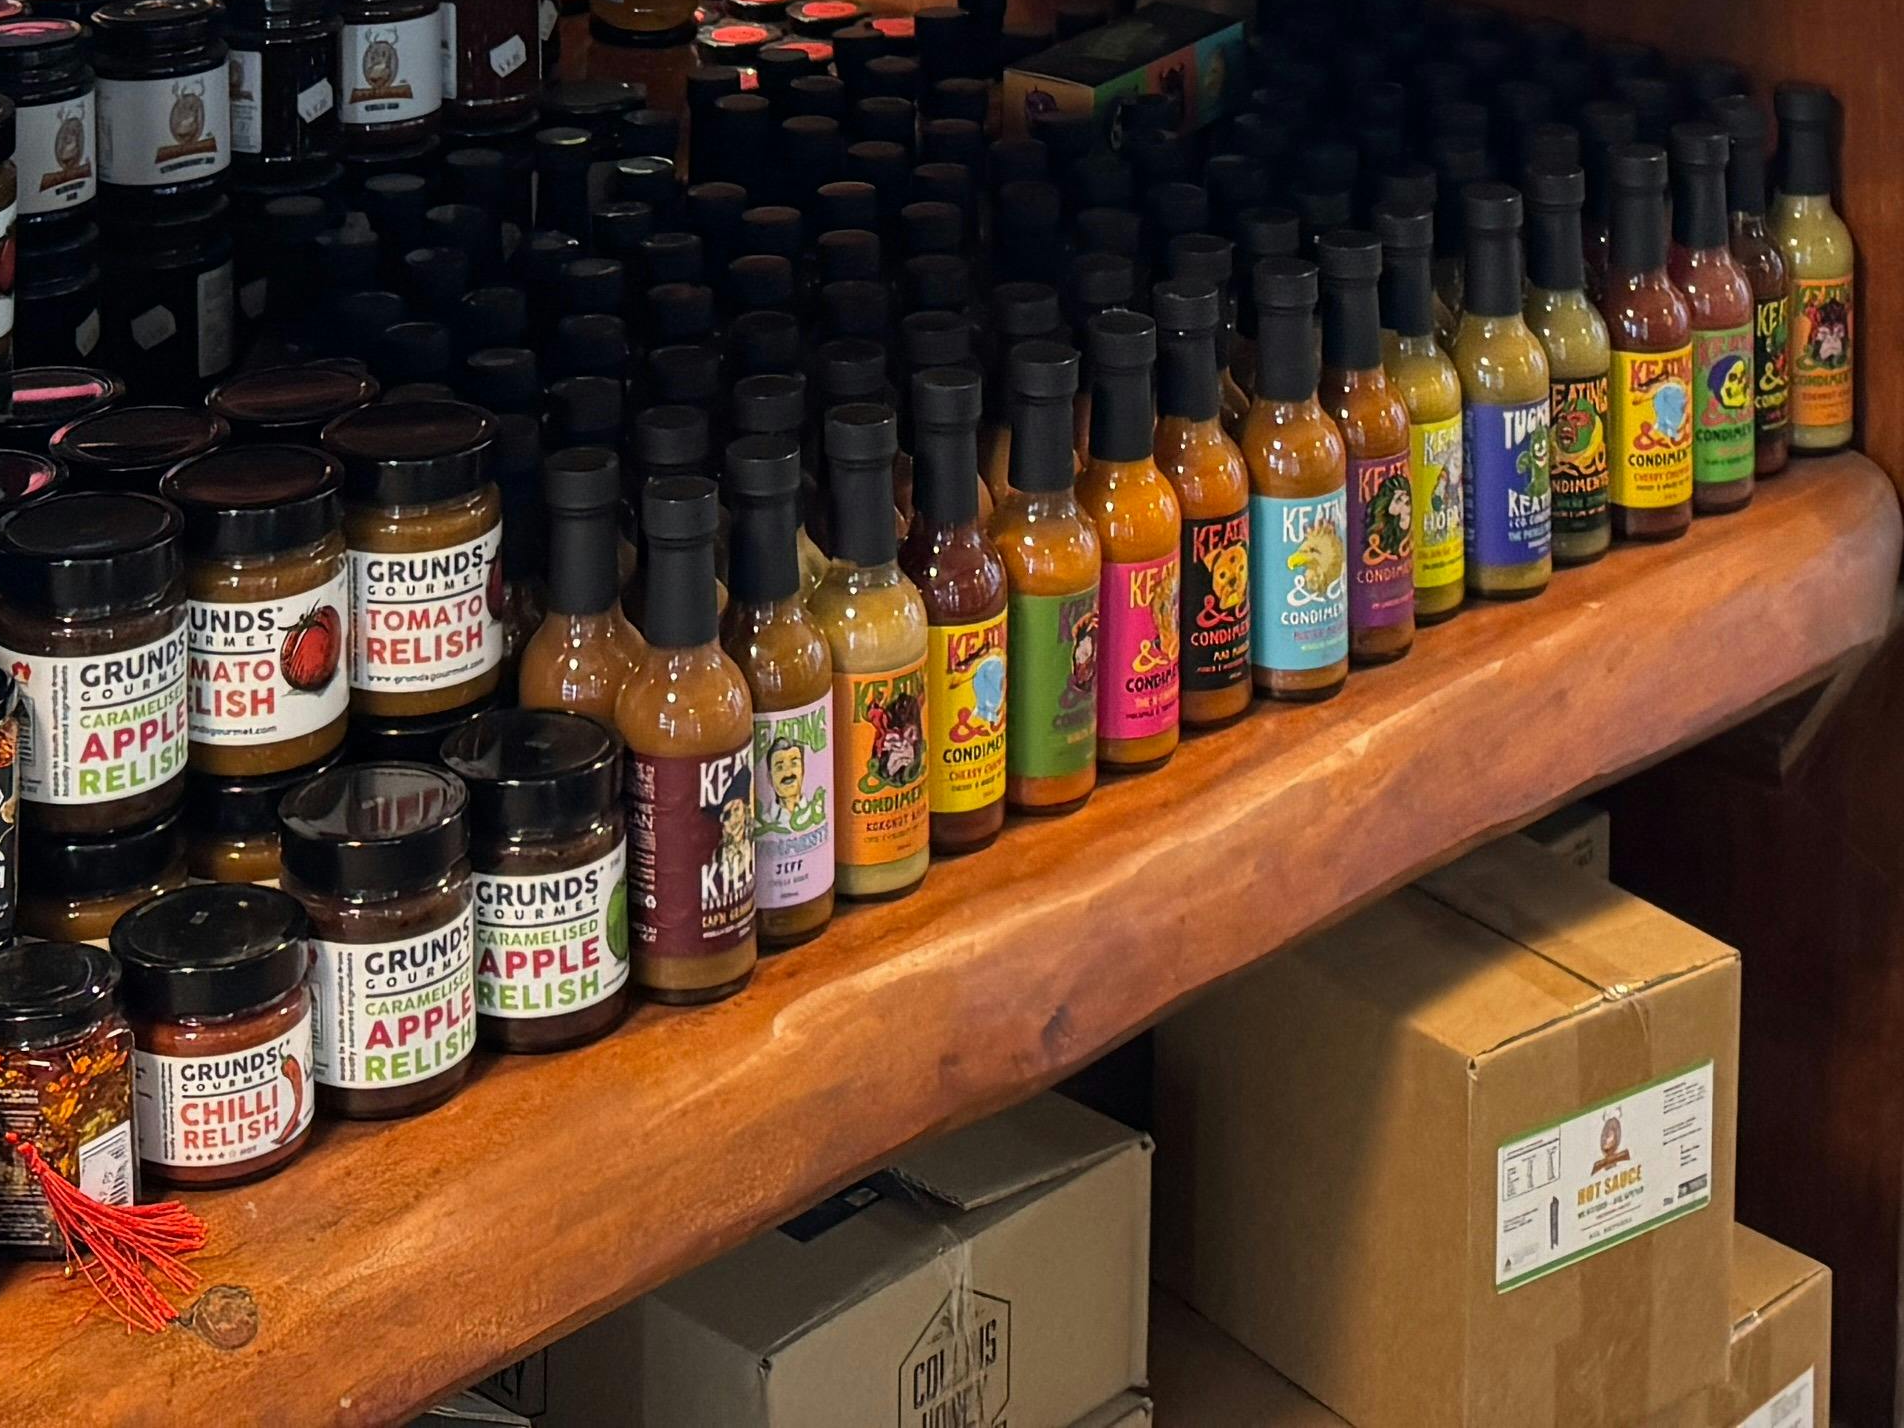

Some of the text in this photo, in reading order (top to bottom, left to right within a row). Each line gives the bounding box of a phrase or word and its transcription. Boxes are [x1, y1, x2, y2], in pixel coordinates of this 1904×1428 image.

[366, 570, 484, 597] GOURMET
[366, 595, 483, 633] TOMATO
[366, 625, 484, 666] RELISH
[190, 658, 275, 685] MATO
[79, 699, 186, 764] APPLE
[79, 742, 187, 797] RELISH
[476, 895, 601, 920] GOURMET
[476, 918, 600, 948] CARAMELISED
[478, 935, 601, 981] APPLE
[478, 970, 601, 1011] RELISH
[364, 984, 473, 1050] APPLE
[364, 1019, 473, 1082] RELISH
[181, 1068, 280, 1093] GOURMET
[180, 1092, 280, 1129] CHILLI
[183, 1119, 281, 1152] RELISH
[1577, 1181, 1601, 1207] HOT
[1604, 1163, 1643, 1196] SAUCE
